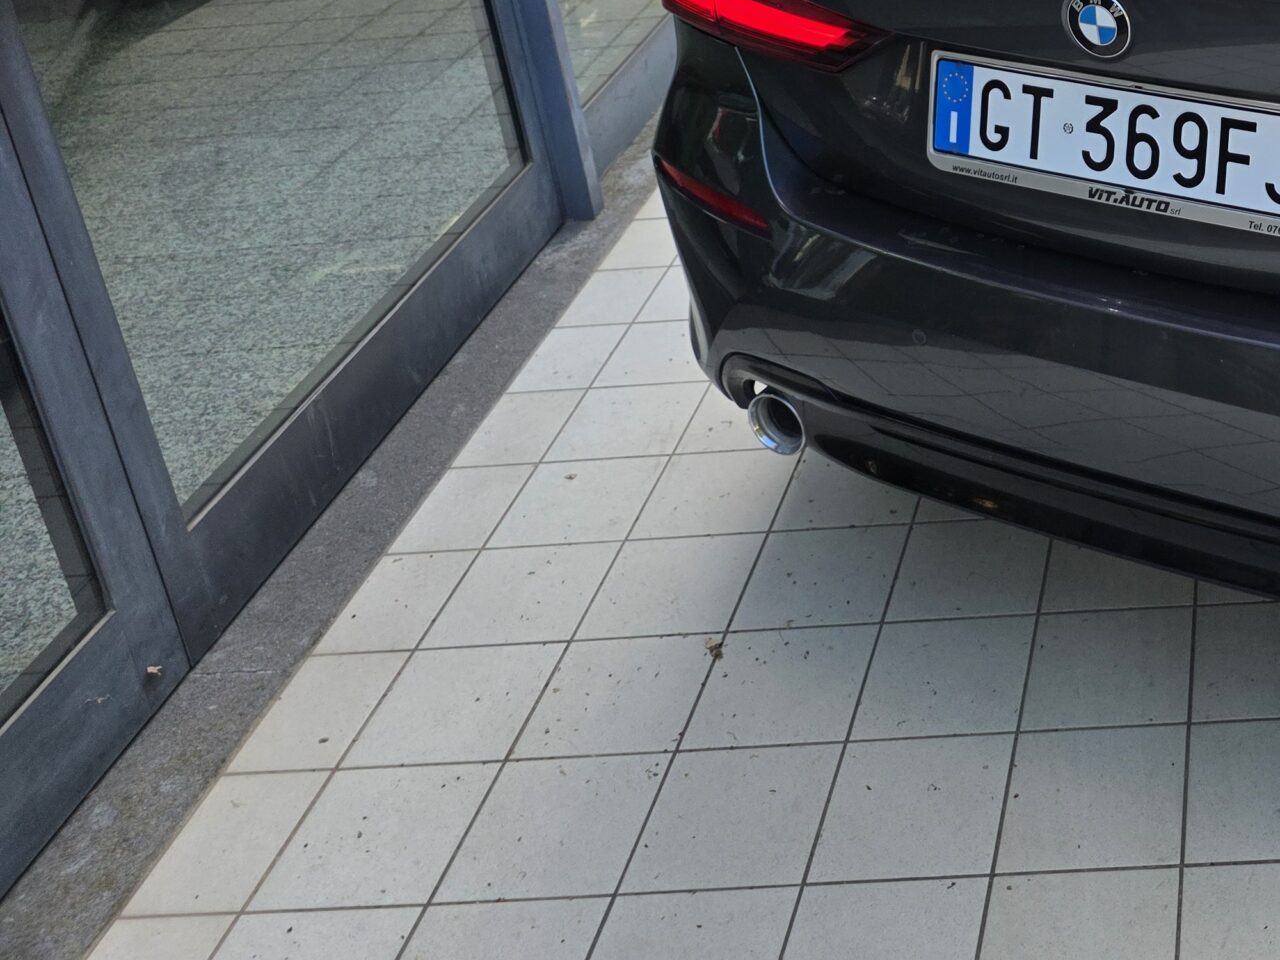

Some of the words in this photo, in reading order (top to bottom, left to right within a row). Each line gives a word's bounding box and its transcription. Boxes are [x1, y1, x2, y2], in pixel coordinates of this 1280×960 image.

[979, 78, 1054, 161] GT
[952, 164, 1018, 184] www.vitautosrl.it
[1169, 207, 1181, 216] srl
[1248, 220, 1264, 232] Tel.
